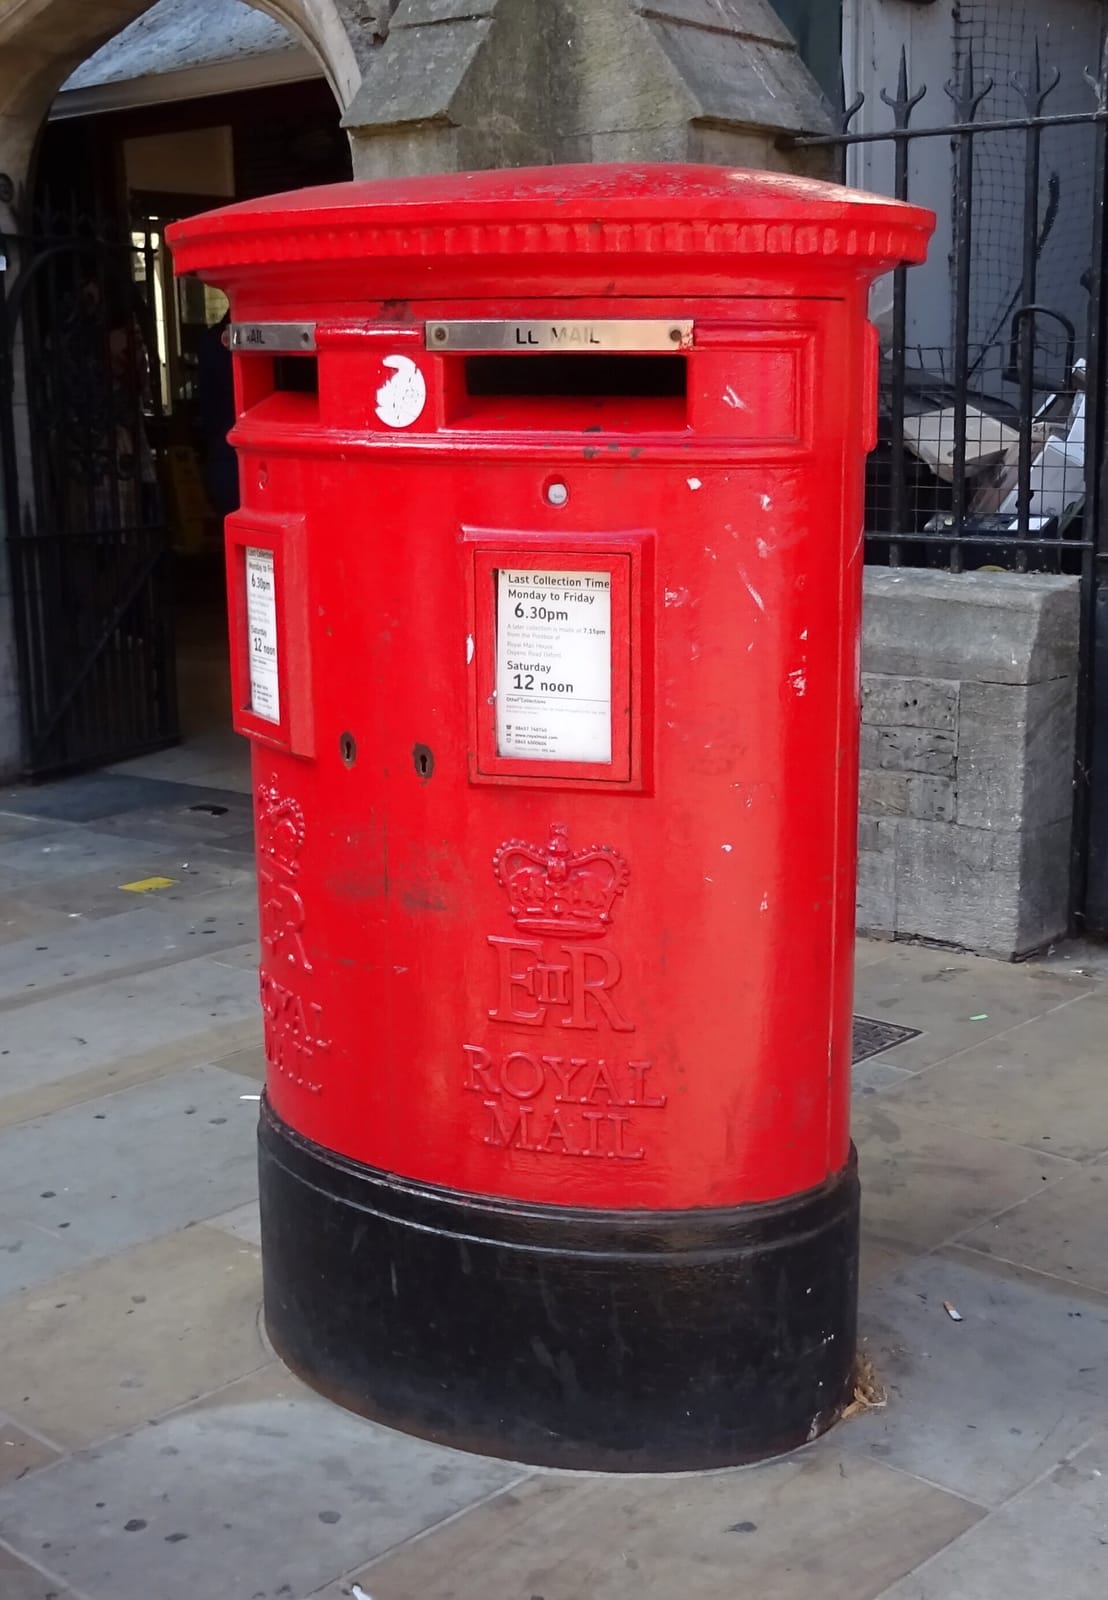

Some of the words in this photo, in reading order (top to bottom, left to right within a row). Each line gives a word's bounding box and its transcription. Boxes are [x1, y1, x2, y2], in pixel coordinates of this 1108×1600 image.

[508, 574, 529, 584] Last
[533, 575, 581, 587] Collection
[585, 578, 610, 588] Time
[508, 589, 547, 602] Monday
[550, 592, 560, 600] to
[564, 592, 595, 604] Friday
[514, 602, 568, 622] 6.30pm
[254, 637, 262, 652] 12
[507, 661, 551, 673] Saturday
[513, 674, 534, 690] 12
[540, 682, 573, 693] noon
[463, 1044, 667, 1108] ROYAL
[484, 1099, 646, 1160] MAIL
